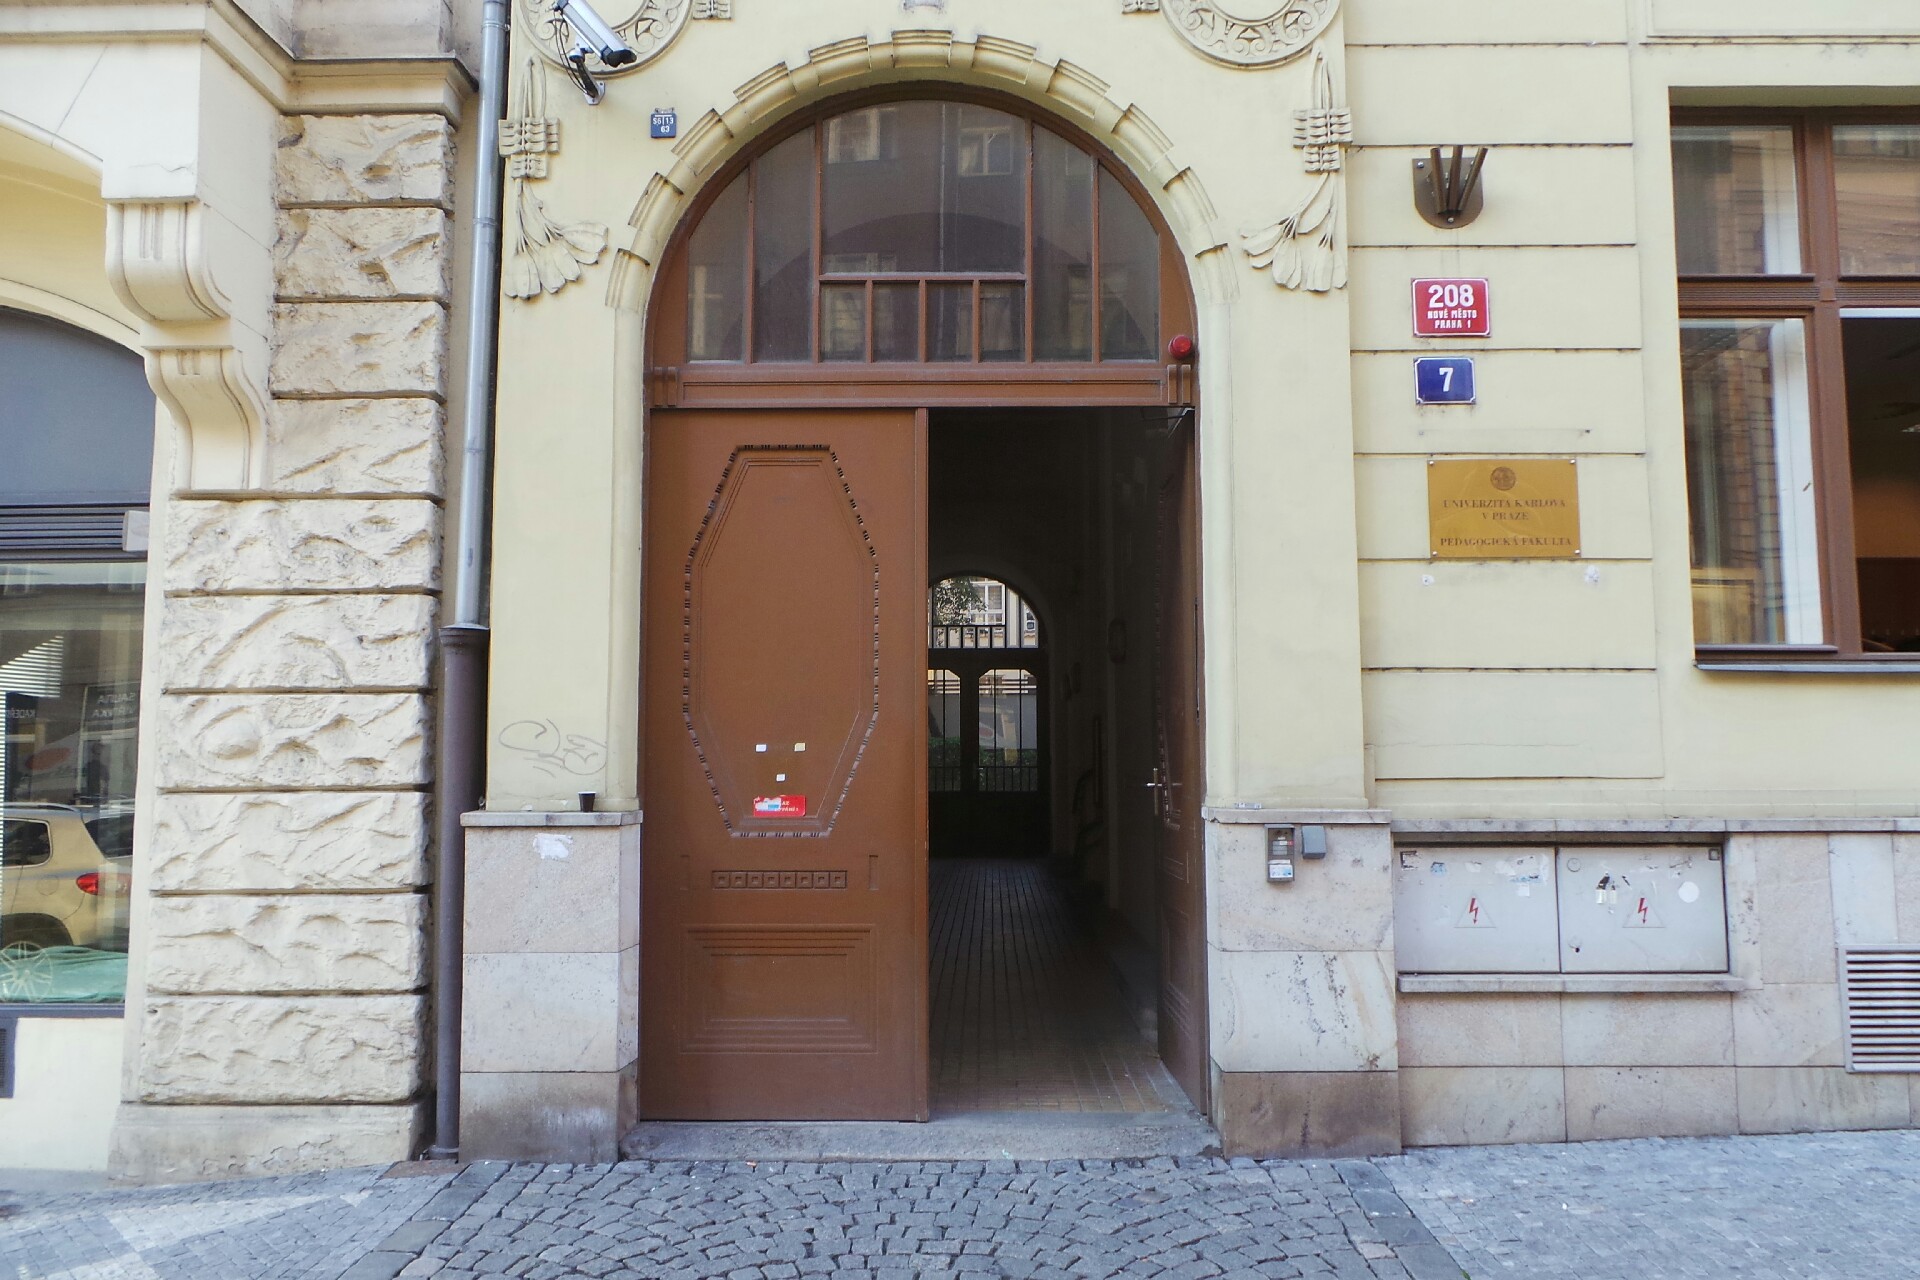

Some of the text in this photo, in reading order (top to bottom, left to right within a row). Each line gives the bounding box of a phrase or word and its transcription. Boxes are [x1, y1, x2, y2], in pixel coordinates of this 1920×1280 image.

[1427, 284, 1475, 308] 208
[1427, 307, 1477, 319] NOVÉ MĚSTO
[1434, 319, 1472, 329] PRAHA 1
[1439, 367, 1454, 392] 7
[1443, 499, 1566, 508] UNIVERZITA KARLOVA
[1481, 511, 1529, 520] V PRAZE
[1440, 535, 1573, 546] PEDAGOGICKÁ FAKULTA
